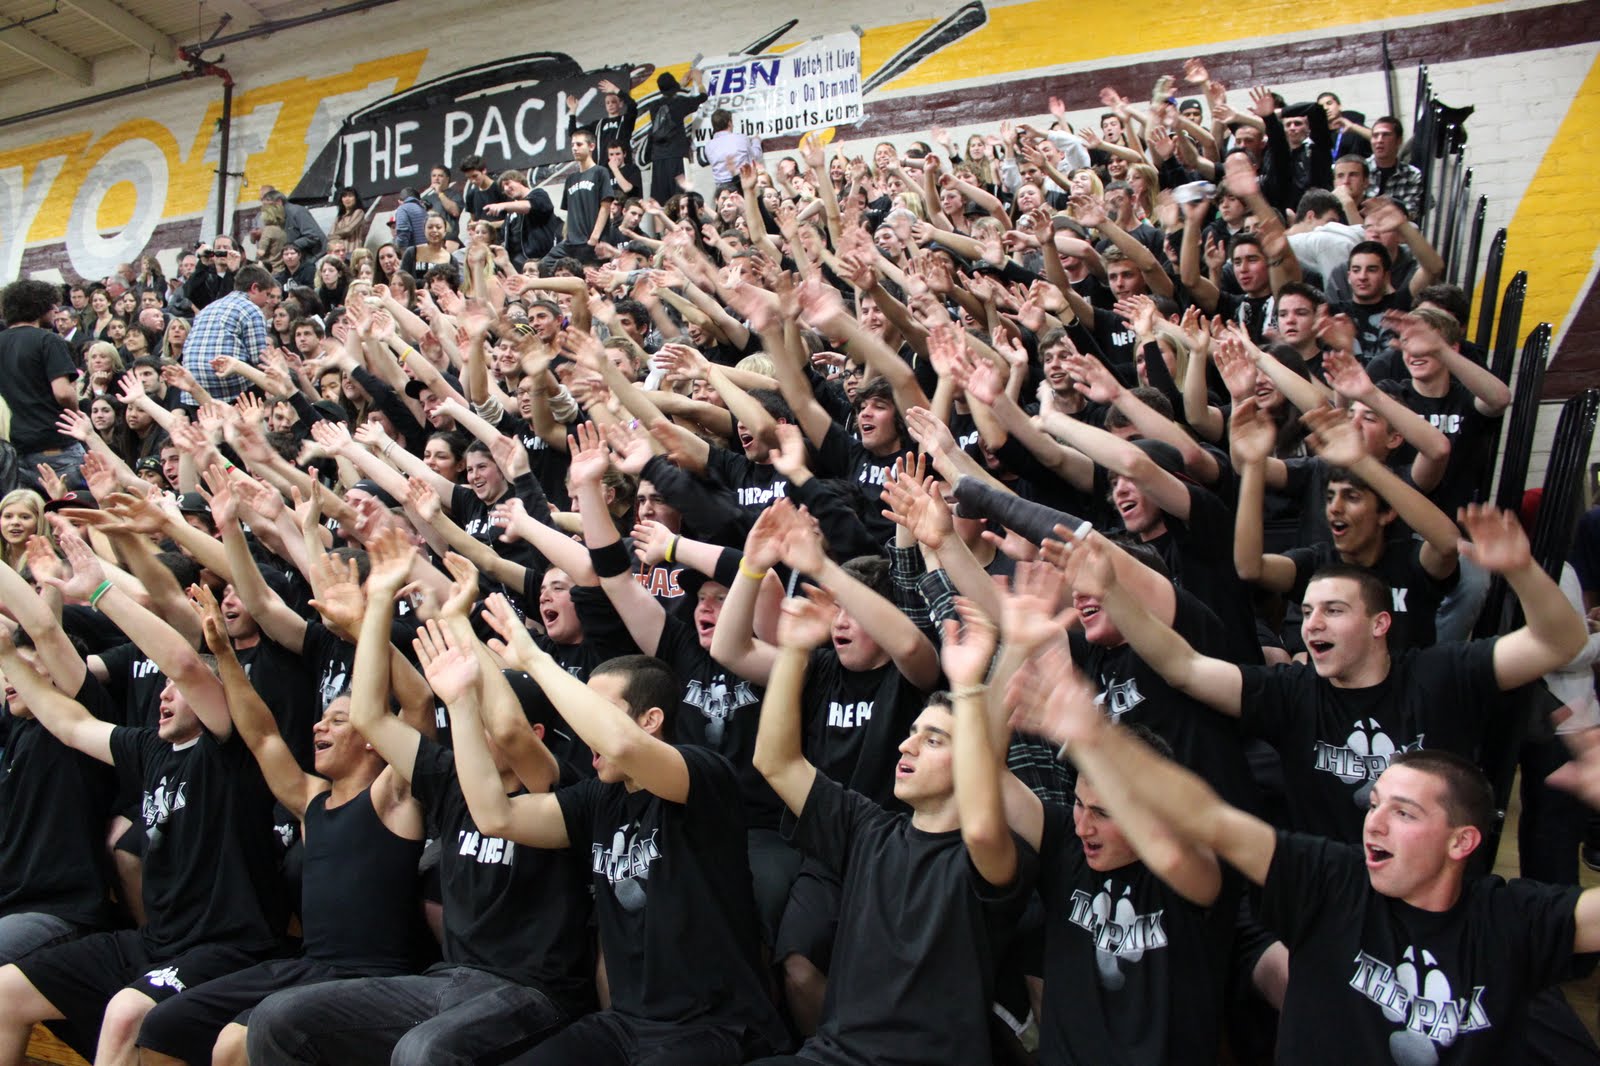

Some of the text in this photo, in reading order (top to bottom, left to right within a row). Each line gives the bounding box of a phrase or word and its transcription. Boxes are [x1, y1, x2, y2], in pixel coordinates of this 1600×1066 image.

[793, 48, 855, 78] Watch it Live
[803, 83, 815, 102] On
[341, 87, 599, 188] THE PACK
[1430, 414, 1464, 434] PAC
